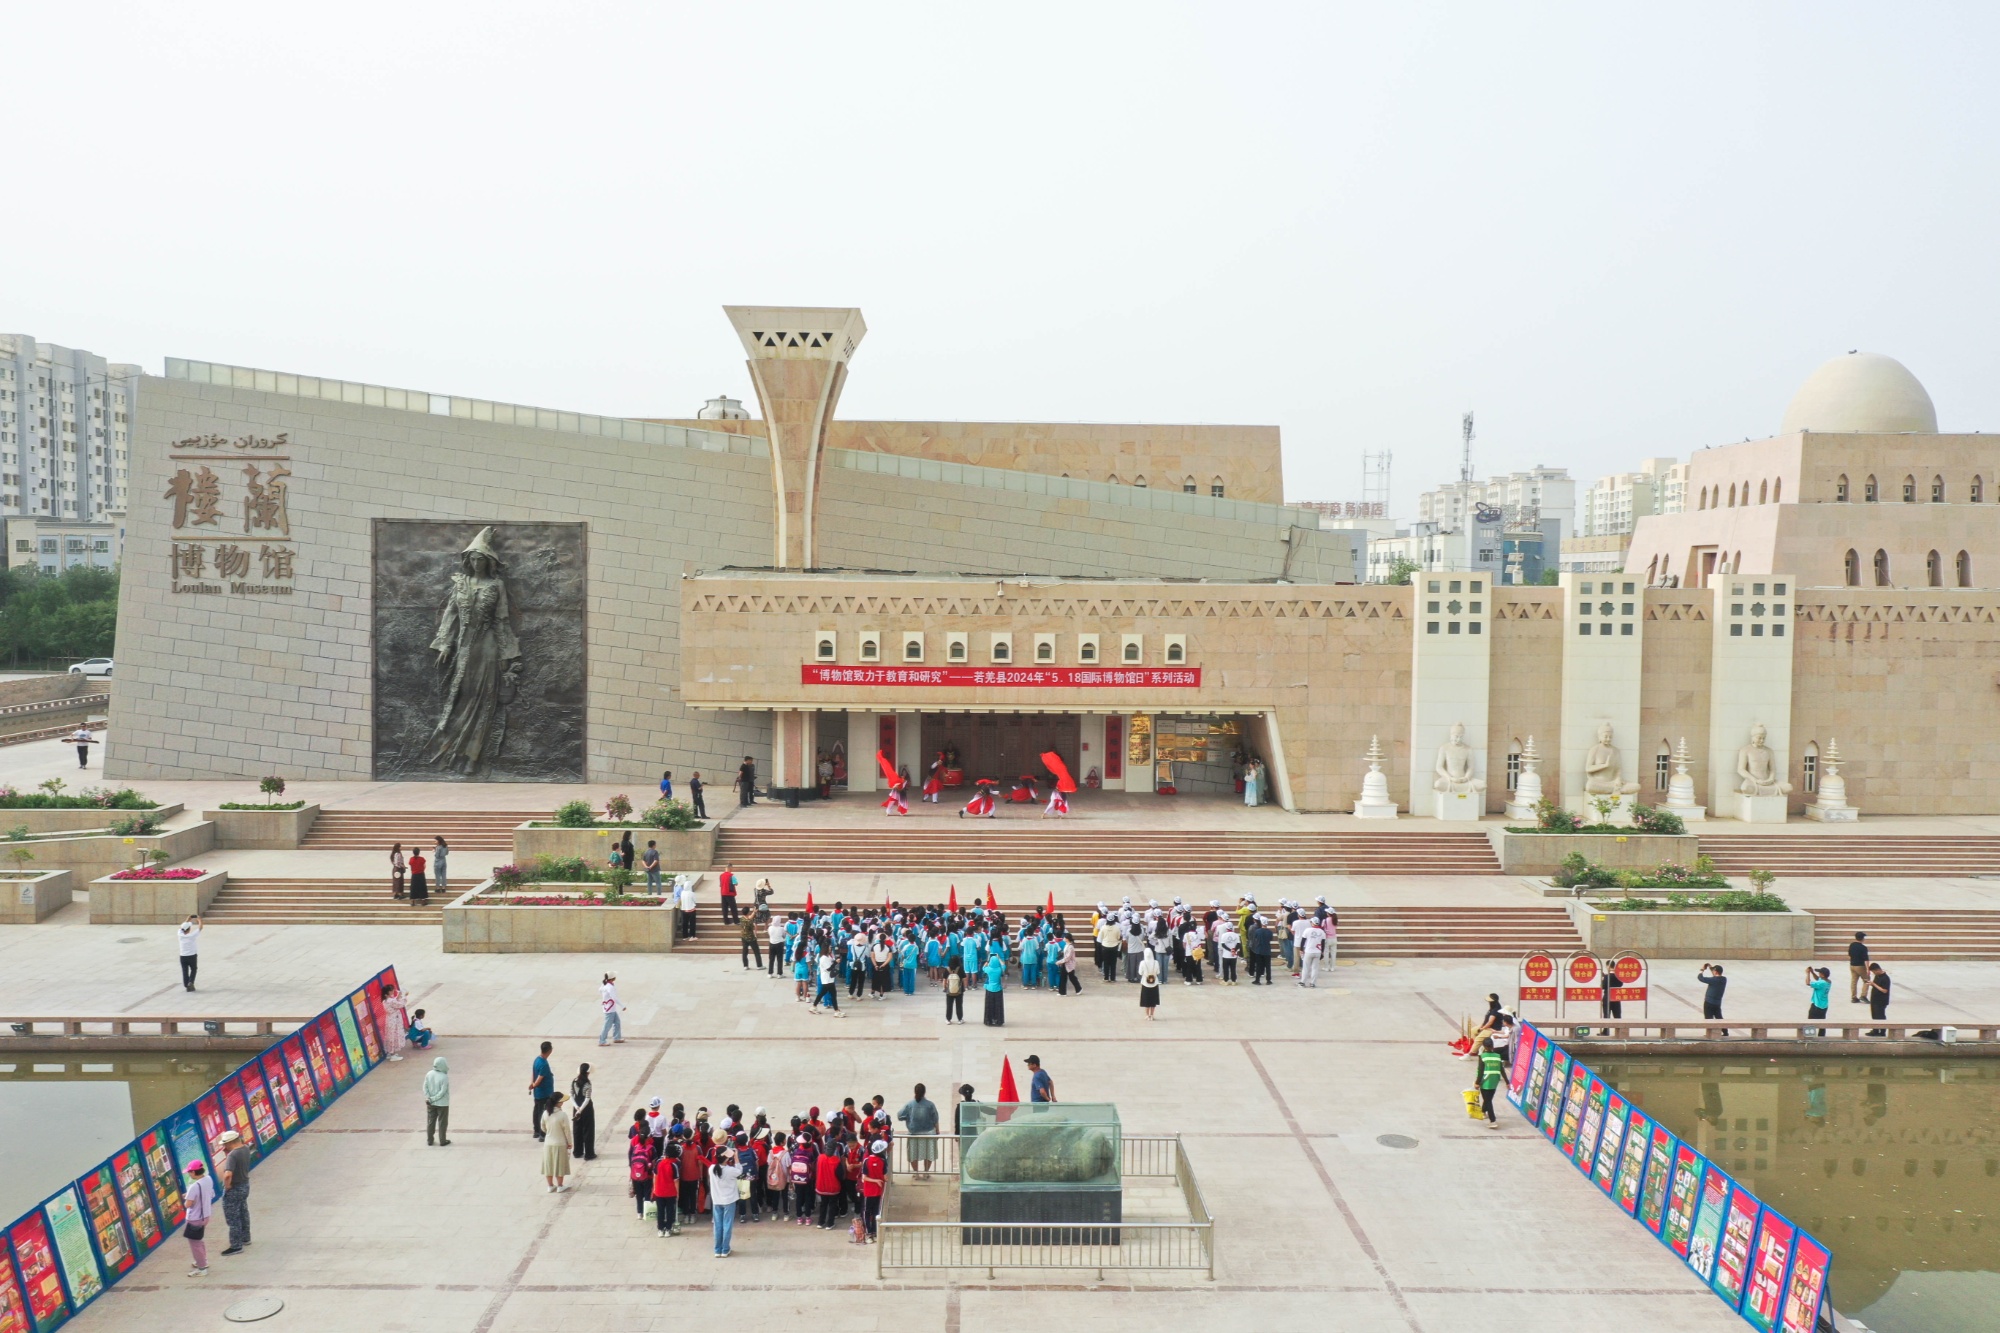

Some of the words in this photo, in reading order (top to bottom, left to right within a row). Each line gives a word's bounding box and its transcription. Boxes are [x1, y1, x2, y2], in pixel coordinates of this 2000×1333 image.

[168, 543, 296, 579] 博物馆
[171, 581, 222, 594] Loulan
[230, 582, 293, 594] Museum
